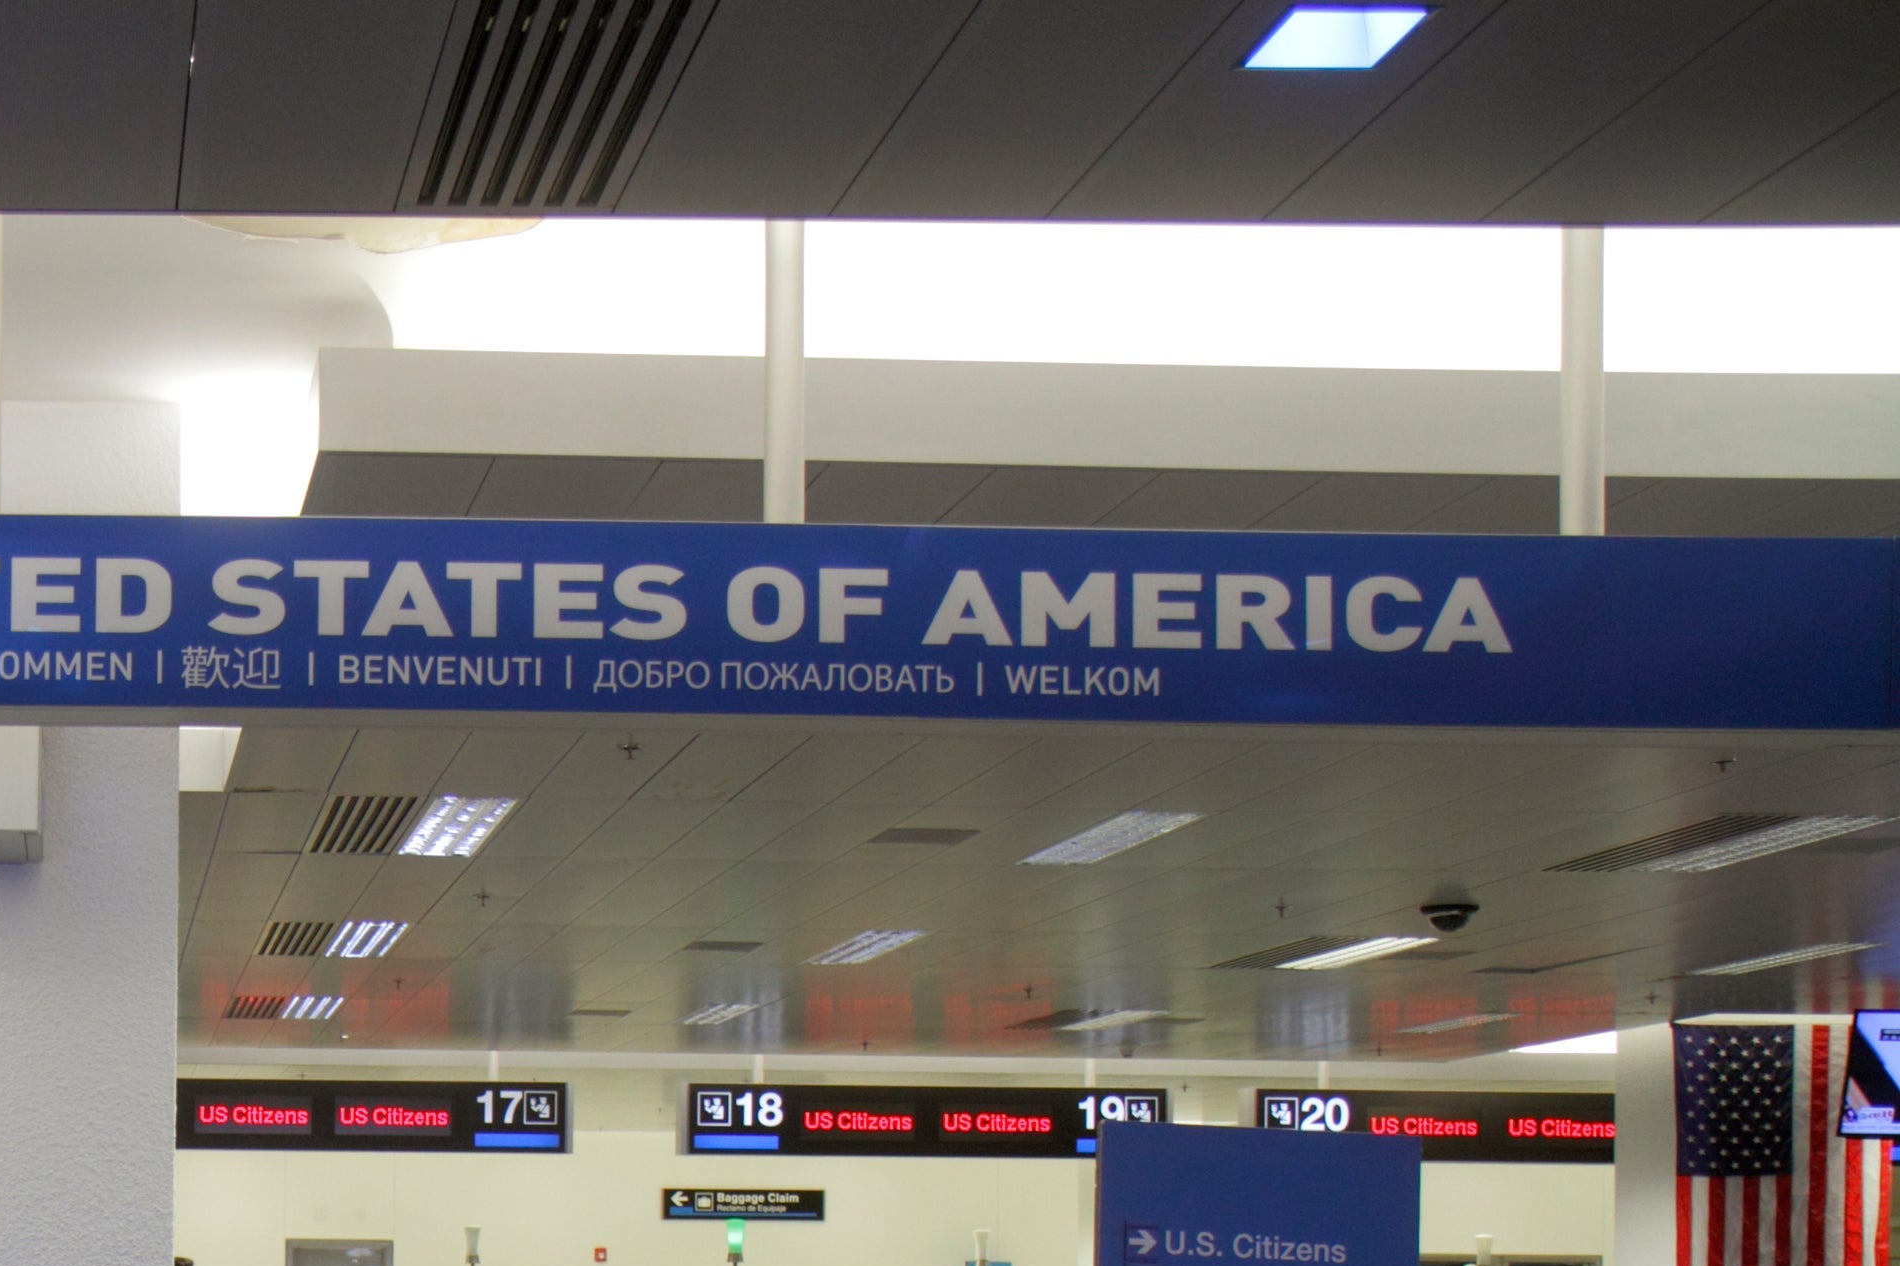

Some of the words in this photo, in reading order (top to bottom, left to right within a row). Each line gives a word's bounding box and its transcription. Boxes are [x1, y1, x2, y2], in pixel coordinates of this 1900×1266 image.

[208, 557, 687, 641] STATES
[726, 565, 889, 643] OF
[922, 569, 1513, 653] AMERICA
[181, 645, 281, 690] 歡迎
[338, 655, 542, 687] BENVENUTI
[593, 659, 711, 694] ДОБРО
[720, 660, 955, 695] ПОЖАЛОВАТЬ
[1005, 664, 1160, 697] WELKOM
[199, 1106, 228, 1125] US
[231, 1106, 309, 1126] Citizens
[339, 1107, 368, 1126] US
[372, 1107, 449, 1127] Citizens
[476, 1089, 524, 1125] 17
[735, 1092, 785, 1127] 18
[804, 1111, 833, 1130] US
[836, 1111, 913, 1131] Citizens
[942, 1112, 972, 1132] US
[975, 1113, 1052, 1133] Citizens
[1078, 1095, 1125, 1130] 19
[1300, 1096, 1350, 1133] 20
[1370, 1116, 1400, 1135] US
[1403, 1117, 1478, 1137] Citizens
[1508, 1118, 1538, 1137] US
[1541, 1118, 1616, 1138] Citizens
[717, 1192, 766, 1205] Baggage
[767, 1192, 800, 1204] Claim
[1164, 1230, 1223, 1257] U.S.
[1232, 1233, 1347, 1264] Citizens
